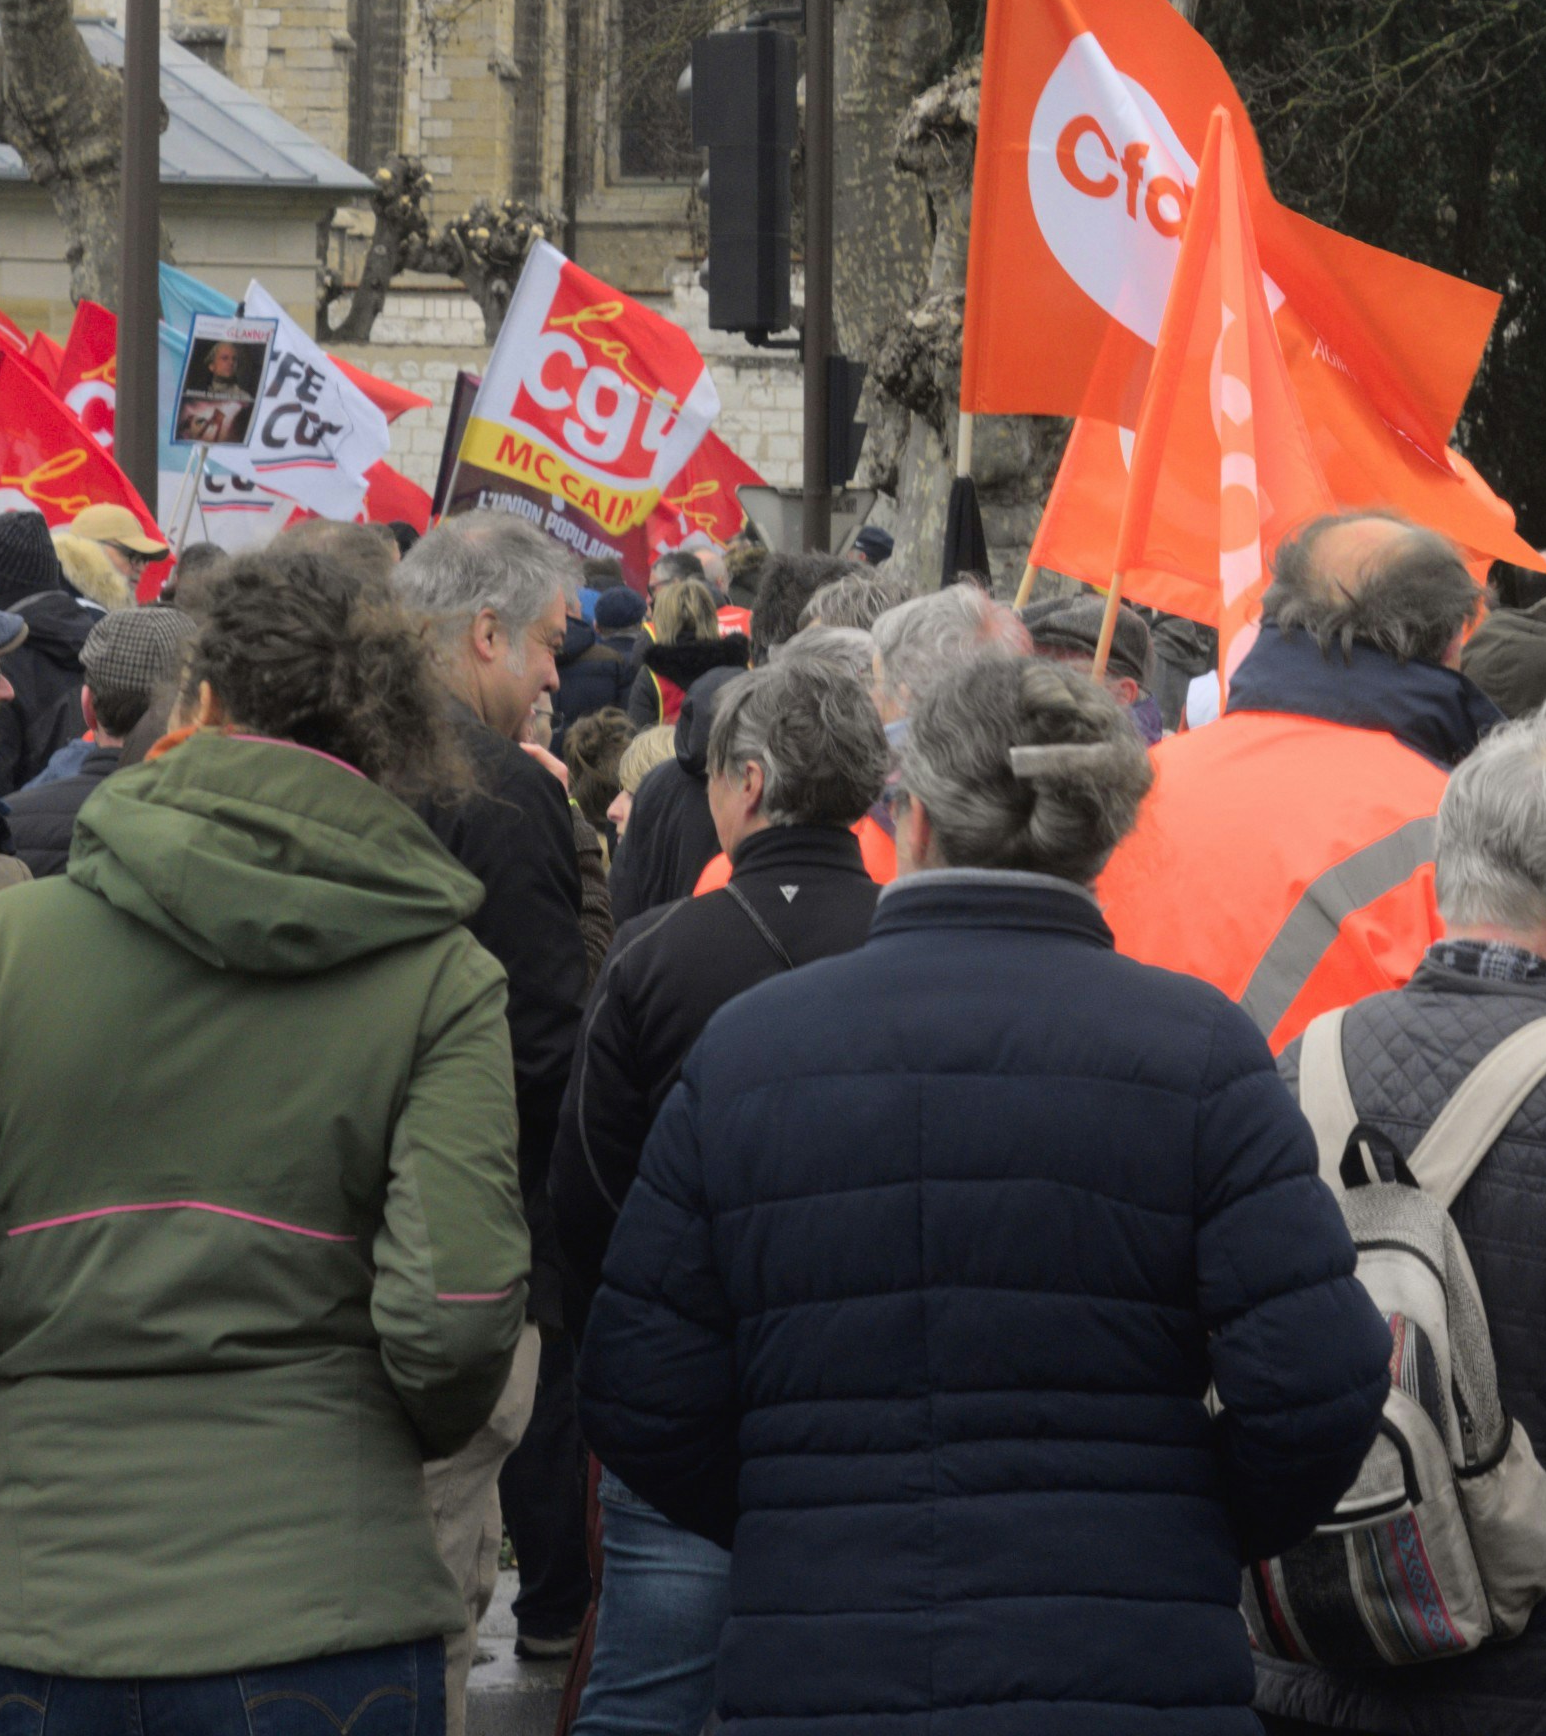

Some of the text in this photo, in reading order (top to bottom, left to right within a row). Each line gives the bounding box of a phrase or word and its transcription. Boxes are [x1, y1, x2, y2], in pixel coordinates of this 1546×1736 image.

[550, 301, 656, 389] la
[521, 331, 679, 464] cgt
[477, 490, 544, 526] L'UNION
